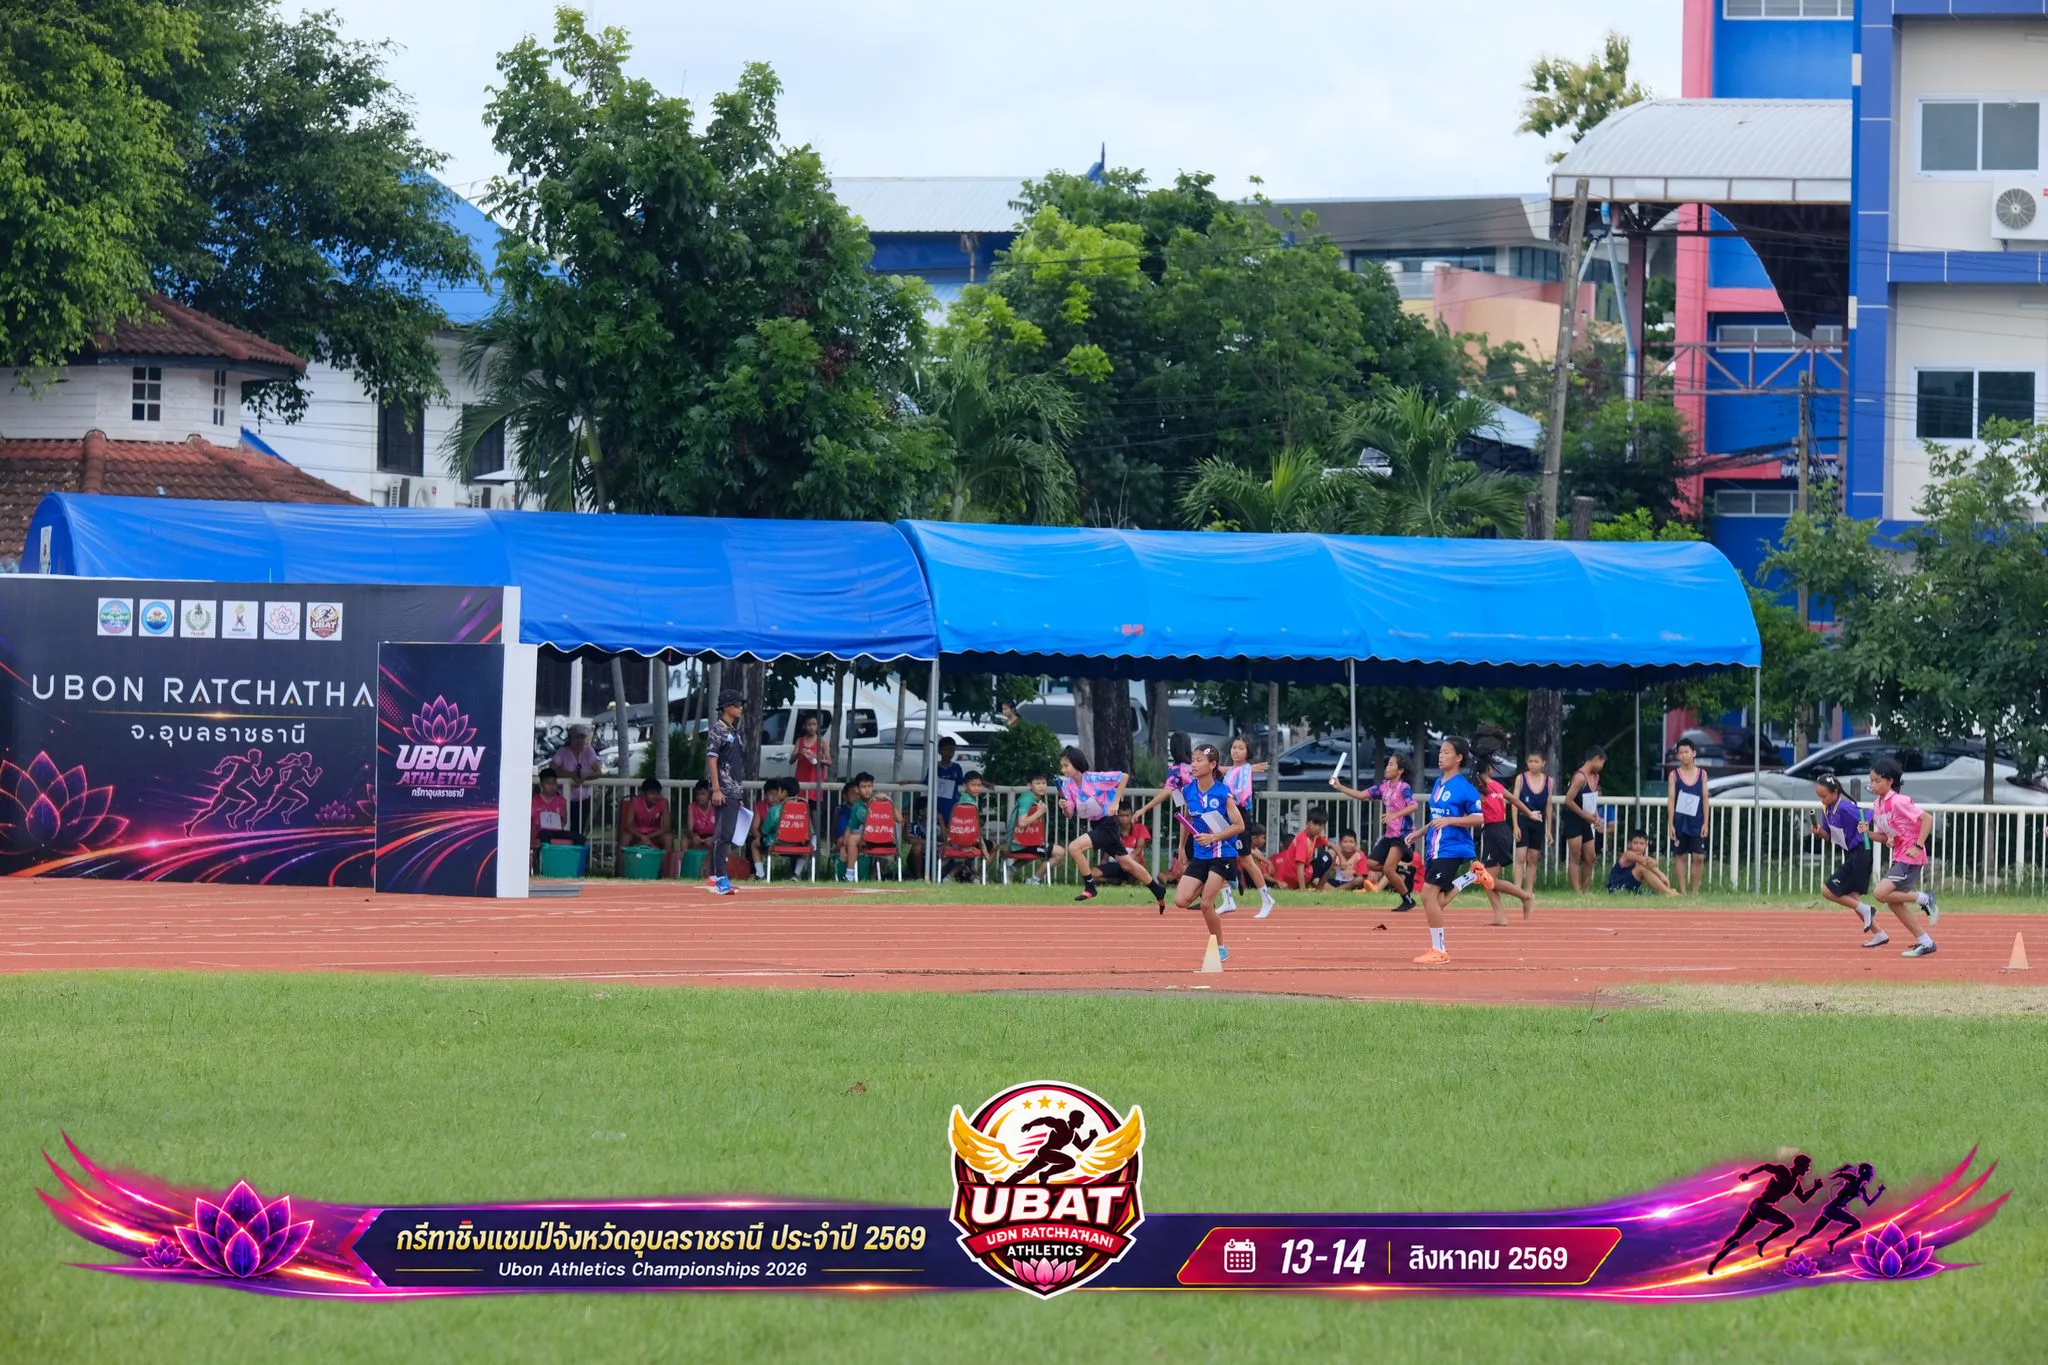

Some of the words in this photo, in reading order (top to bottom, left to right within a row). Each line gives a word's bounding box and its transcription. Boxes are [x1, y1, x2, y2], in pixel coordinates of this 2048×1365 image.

[32, 674, 143, 701] UBON
[163, 677, 374, 707] RATCHATHA
[131, 722, 305, 748] จ.อุบลราชธานี
[396, 745, 486, 771] UBON
[396, 771, 481, 785] ATHLETICS
